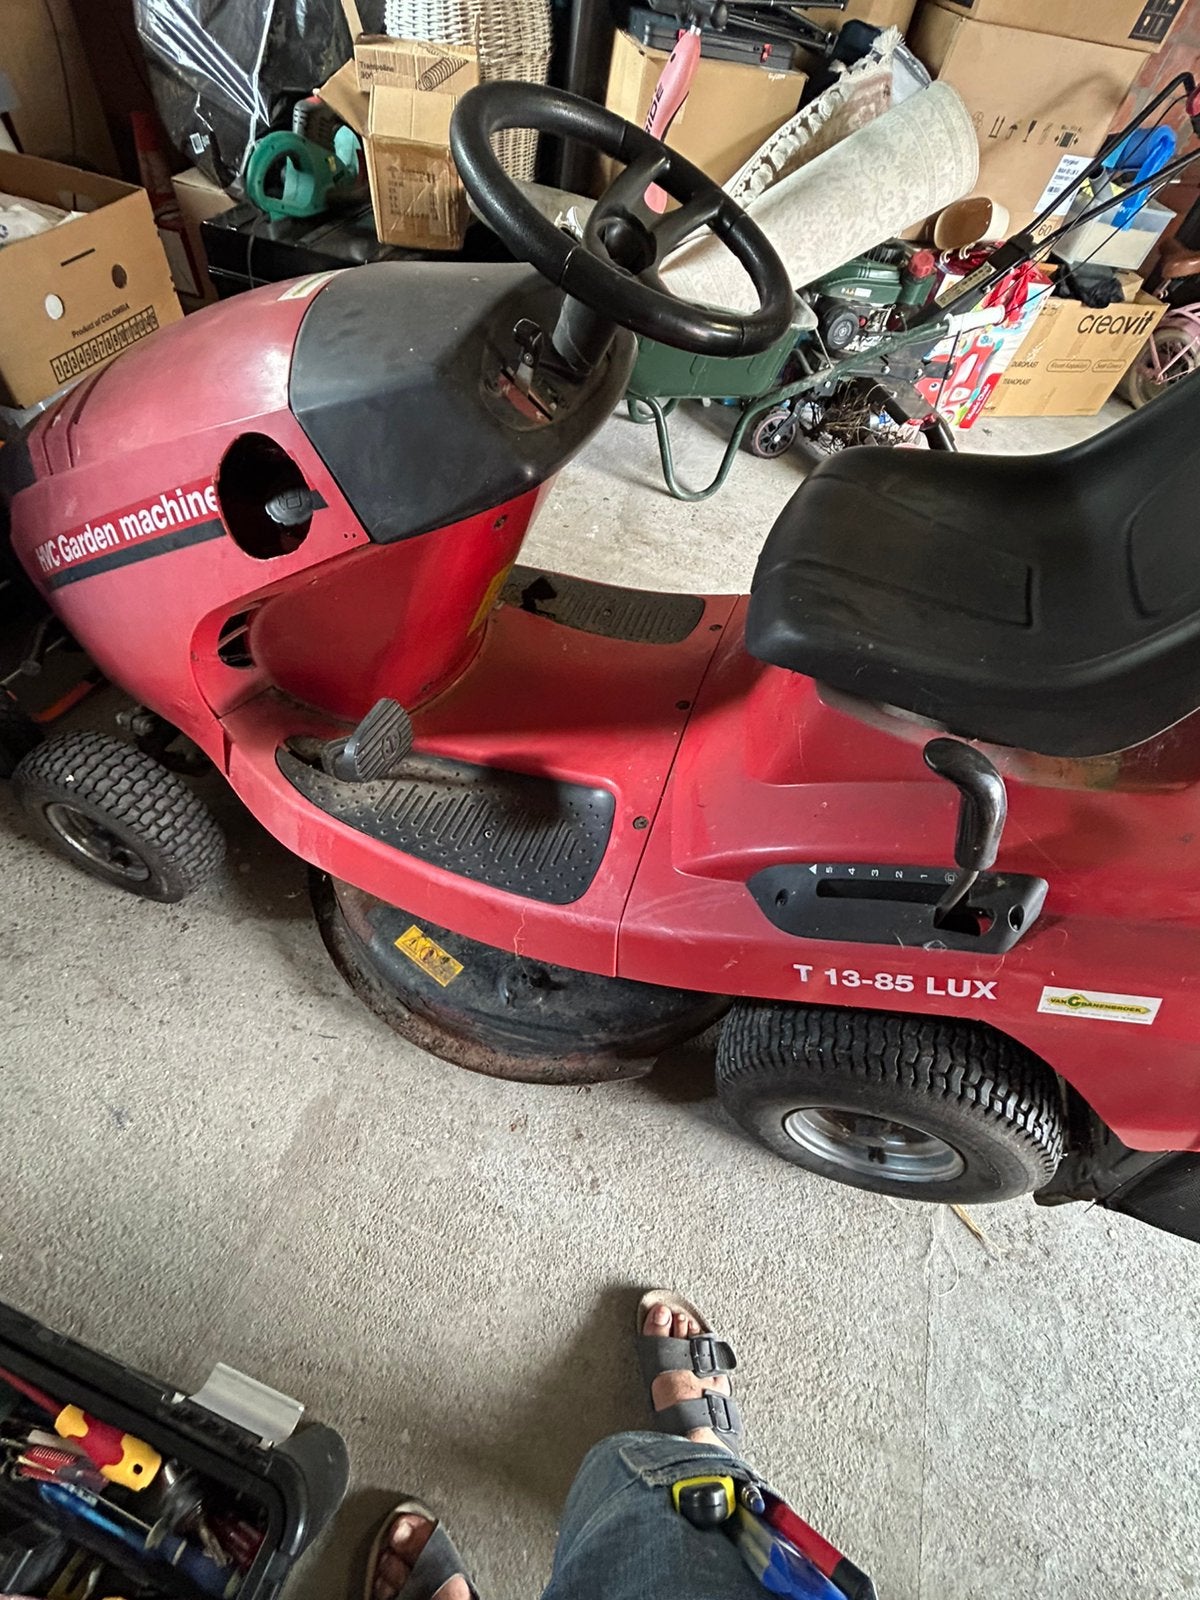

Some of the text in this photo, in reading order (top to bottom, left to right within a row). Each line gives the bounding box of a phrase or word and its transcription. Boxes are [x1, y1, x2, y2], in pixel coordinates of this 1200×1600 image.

[1038, 224, 1053, 236] 60
[71, 321, 95, 338] Product
[101, 302, 130, 324] COLOMBIA
[1077, 310, 1156, 335] creavit
[35, 486, 220, 573] HVC Garden machine
[848, 867, 856, 876] 4
[871, 869, 879, 877] 3
[895, 870, 903, 878] 2
[793, 963, 998, 1000] T 13-85 LUX
